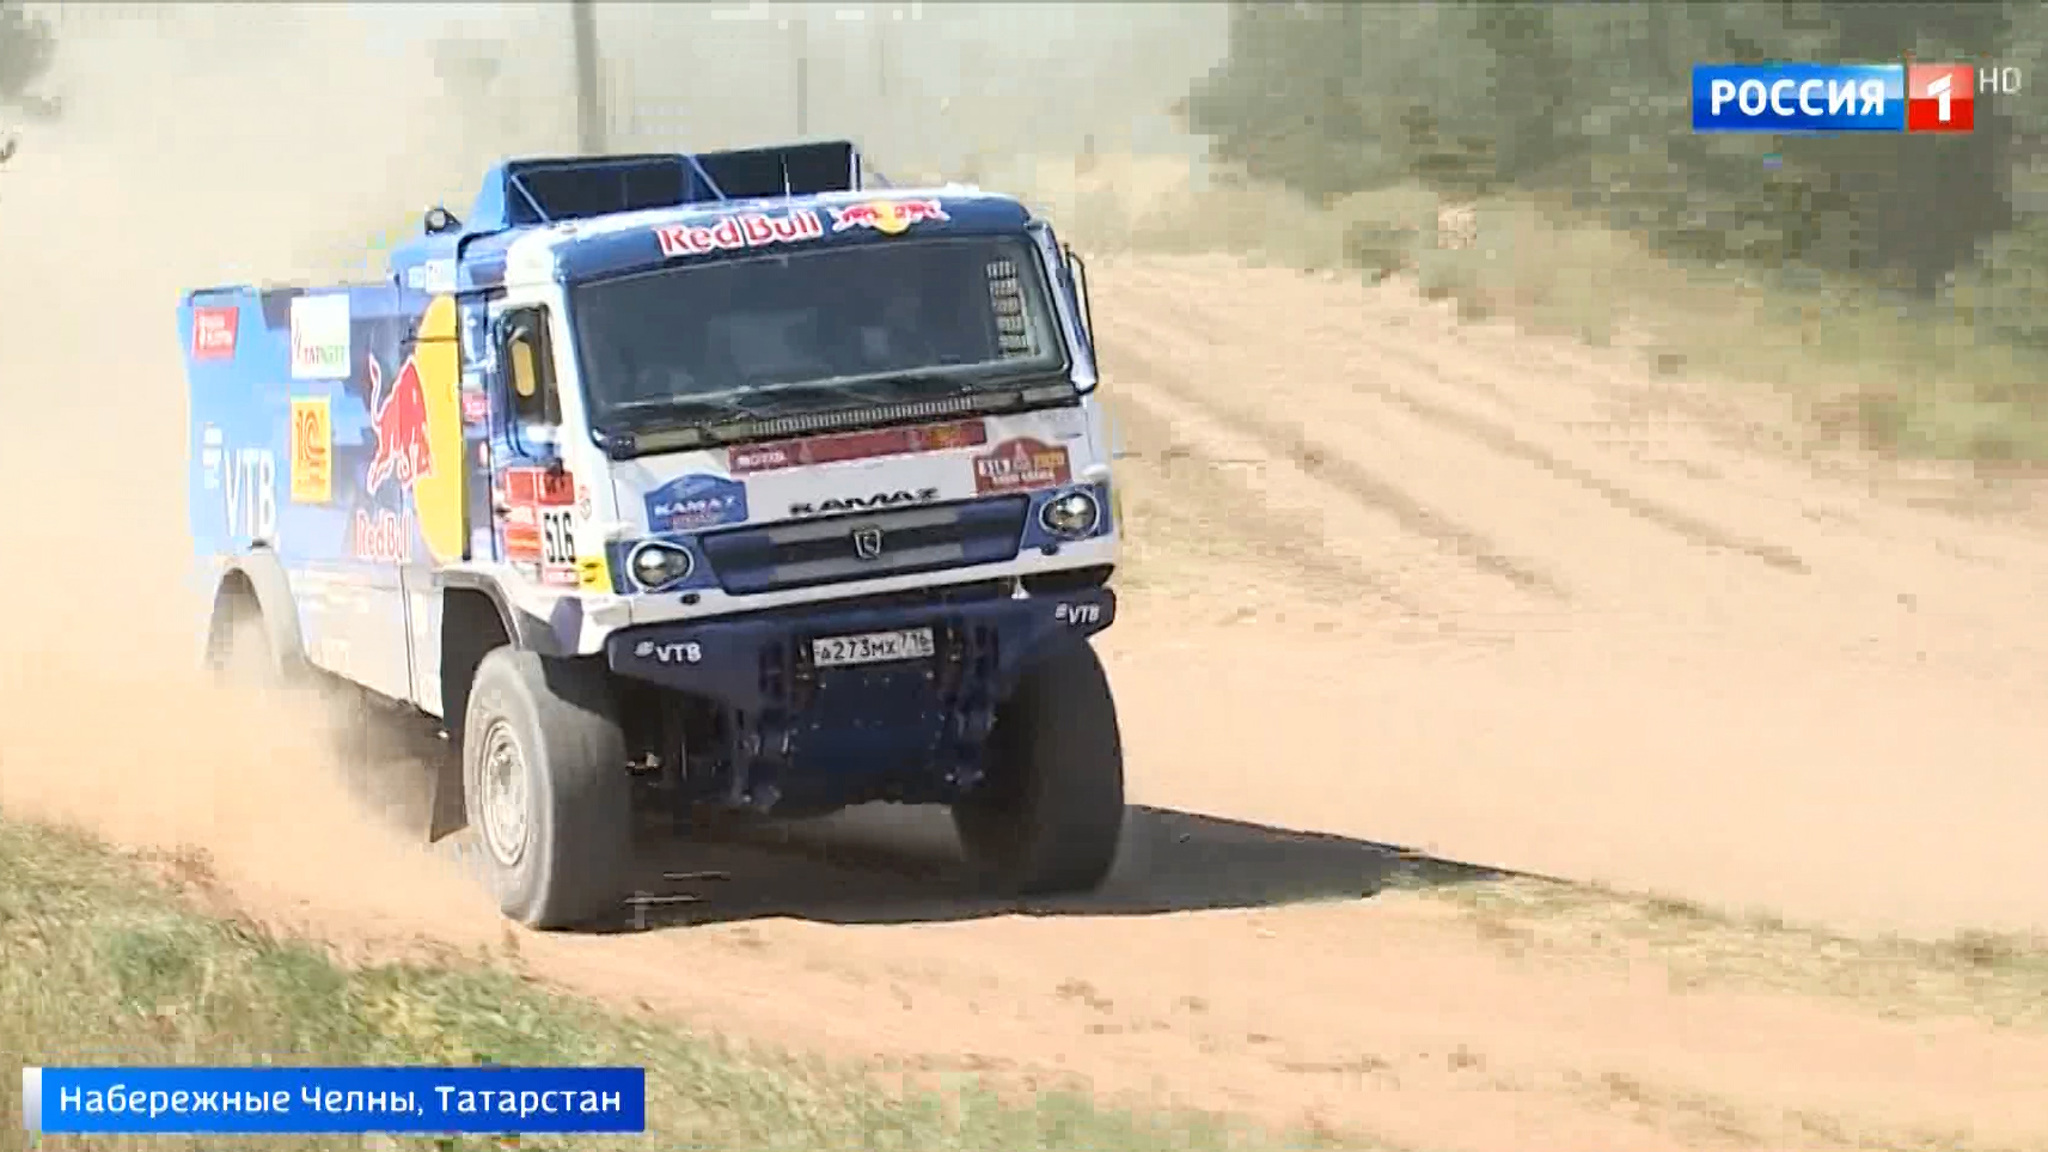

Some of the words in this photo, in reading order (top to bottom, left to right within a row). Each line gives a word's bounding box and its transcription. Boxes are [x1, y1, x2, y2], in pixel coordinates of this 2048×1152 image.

[656, 217, 744, 257] Red
[740, 210, 824, 246] Bull
[224, 448, 276, 537] VTB
[789, 487, 940, 516] KAMAZ
[356, 509, 384, 557] Red
[382, 507, 413, 563] Bull
[543, 511, 577, 563] 516
[1068, 605, 1101, 624] VTB
[656, 642, 702, 663] VTB
